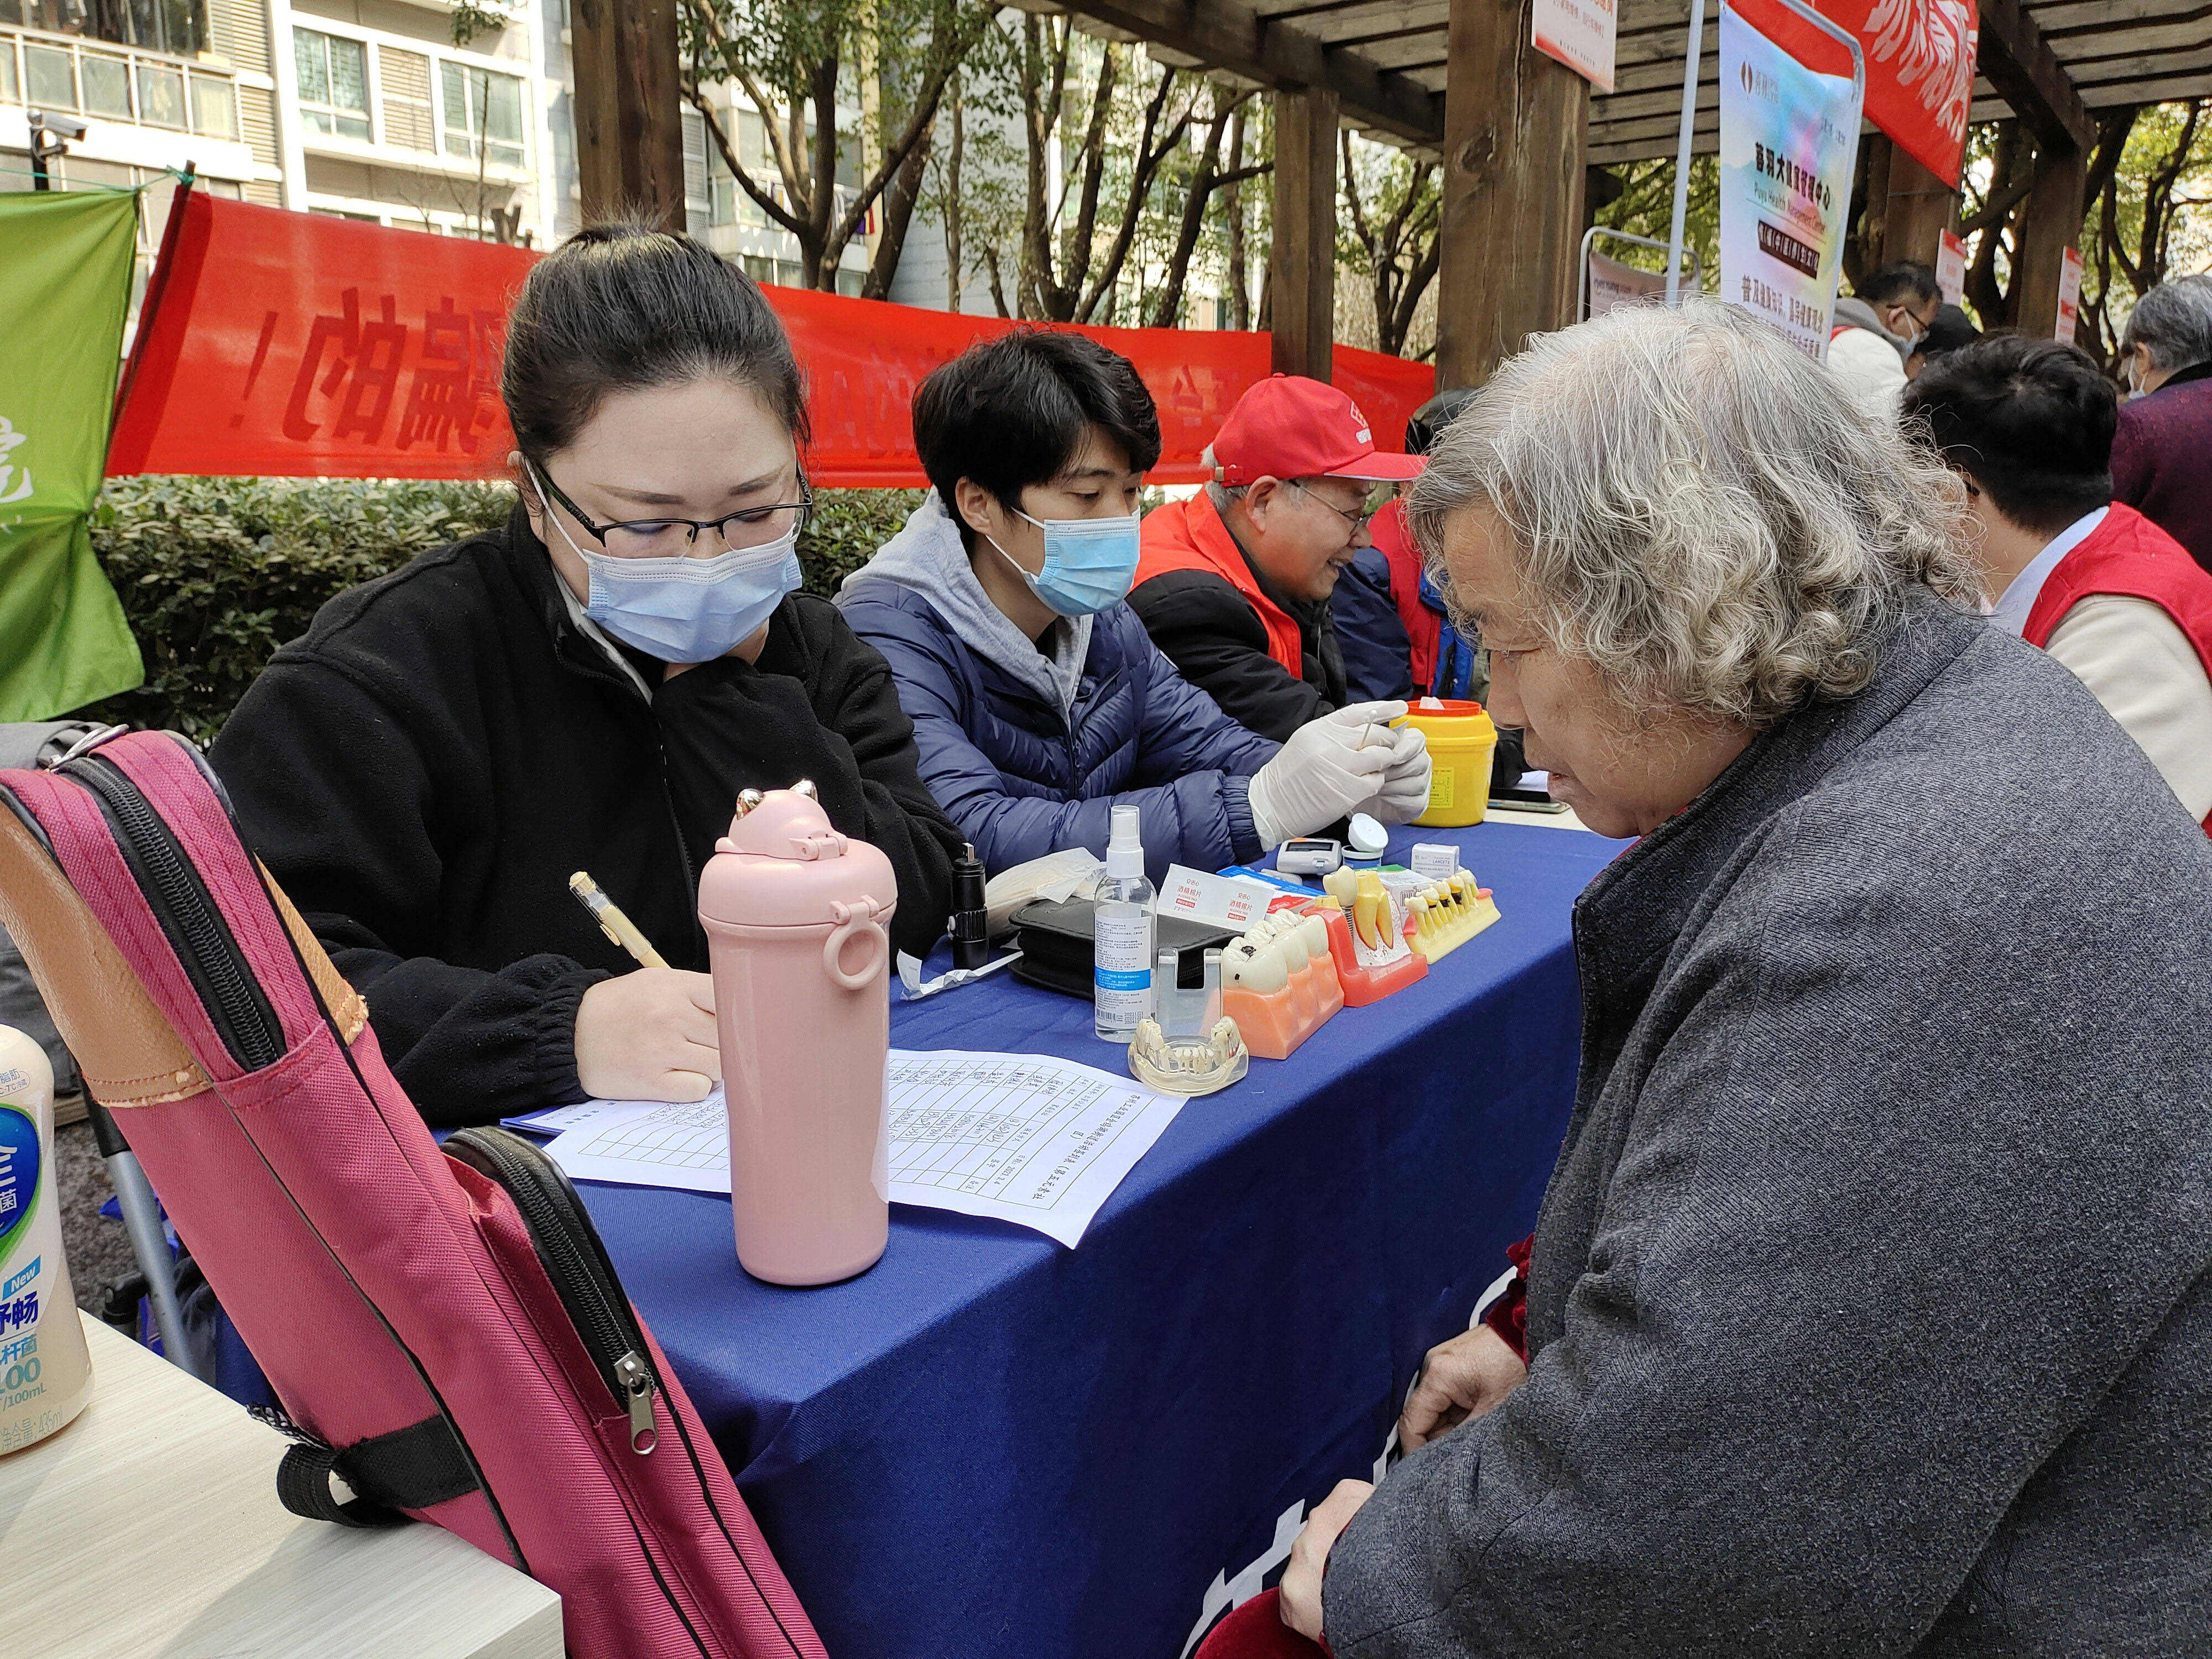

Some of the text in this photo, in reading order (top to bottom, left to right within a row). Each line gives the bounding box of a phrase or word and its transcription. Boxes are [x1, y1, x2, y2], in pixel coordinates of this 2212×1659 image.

[1768, 189, 1785, 211] Health
[1177, 885, 1202, 899] 酒精棉片
[1230, 900, 1253, 912] 酒精棉片
[0, 1068, 20, 1084] 脂肪
[1010, 1127, 1033, 1142] 联系方式
[984, 1158, 1002, 1168] 签字
[11, 1265, 36, 1293] New
[0, 1333, 37, 1365] 杆菌
[0, 1357, 41, 1394] 00
[0, 1383, 46, 1412] /100mL
